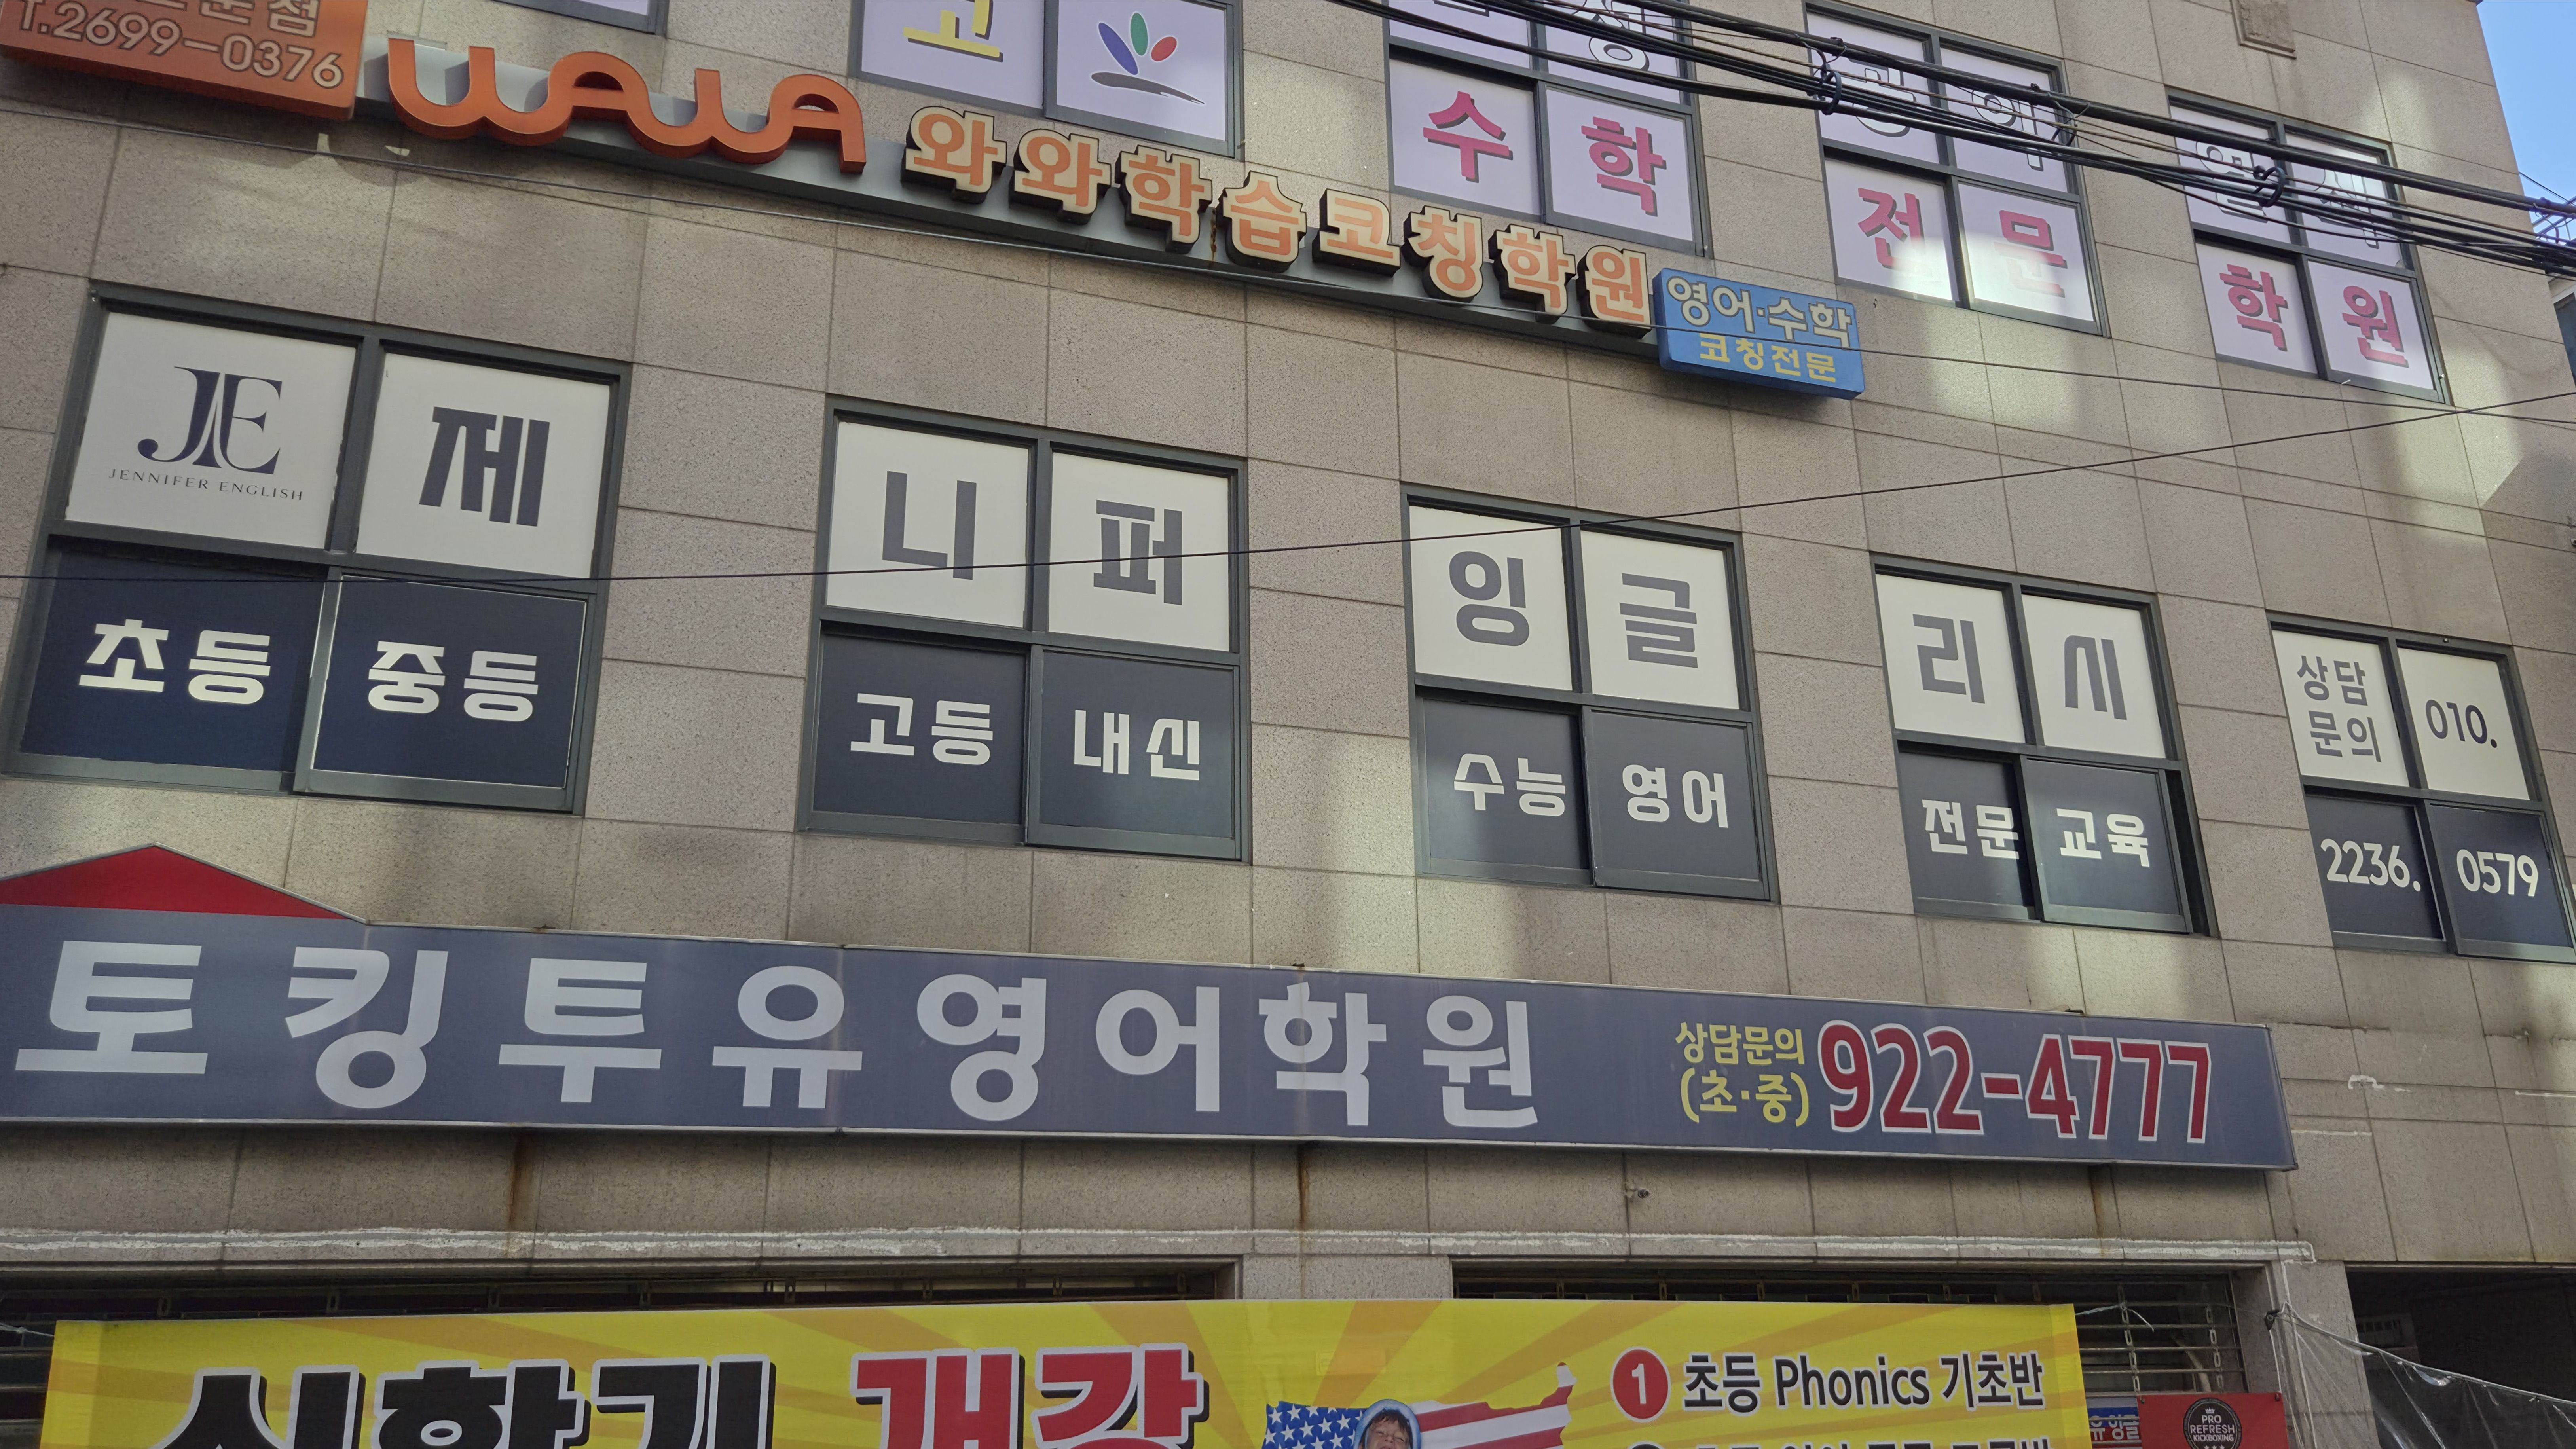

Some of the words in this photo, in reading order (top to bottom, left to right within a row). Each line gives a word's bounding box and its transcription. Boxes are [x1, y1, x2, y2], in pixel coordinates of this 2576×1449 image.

[388, 38, 867, 173] WAWA
[903, 105, 1652, 334] 와와학습코칭학원
[1423, 91, 1667, 216] 수학
[2220, 264, 2409, 368] 학원
[1699, 332, 1837, 384] 코칭전문
[138, 366, 282, 474] JE
[108, 468, 209, 489] JENNIFER
[219, 481, 303, 501] ENGLISH
[2296, 654, 2368, 706] 상담
[79, 619, 271, 704] 초등
[368, 640, 539, 723] 중등
[850, 692, 994, 766] 고등
[1074, 709, 1200, 781] 내신
[1453, 753, 1566, 817] 수능
[1622, 764, 1728, 829] 영어
[1922, 799, 2020, 860] 전문
[2056, 808, 2150, 867] 교육
[2308, 709, 2382, 763] 문의
[2425, 699, 2498, 749] 010.
[2320, 838, 2422, 892] 2236.
[2456, 848, 2539, 897] 0579
[1675, 1021, 1805, 1066] 상담문의
[1818, 1019, 2212, 1144] 922-4777
[1684, 1352, 1760, 1415] 초등
[1774, 1353, 1930, 1408] Phonics
[1940, 1350, 2045, 1411] 기초반
[2190, 1424, 2235, 1434] REFRESH
[2201, 1415, 2222, 1424] PRO
